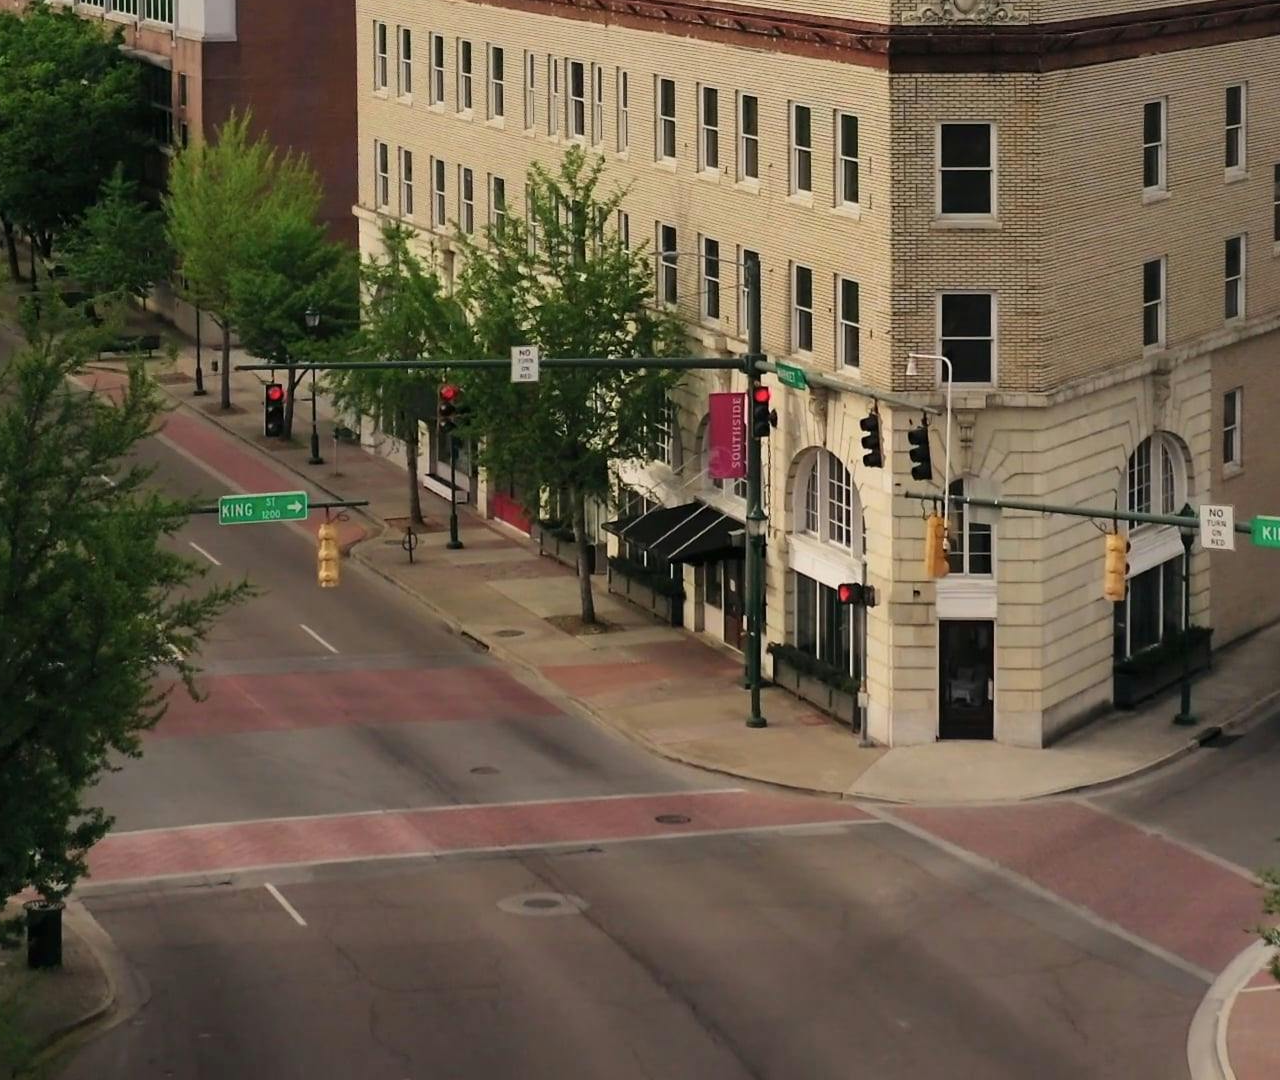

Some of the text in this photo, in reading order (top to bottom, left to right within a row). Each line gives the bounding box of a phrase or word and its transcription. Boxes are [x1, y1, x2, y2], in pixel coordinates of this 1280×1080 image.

[519, 349, 531, 357] NO
[731, 398, 742, 469] SOUTHSIDE
[222, 497, 276, 518] KING ST
[1209, 508, 1224, 518] NO
[1207, 520, 1227, 528] TURN
[1211, 539, 1226, 547] RED
